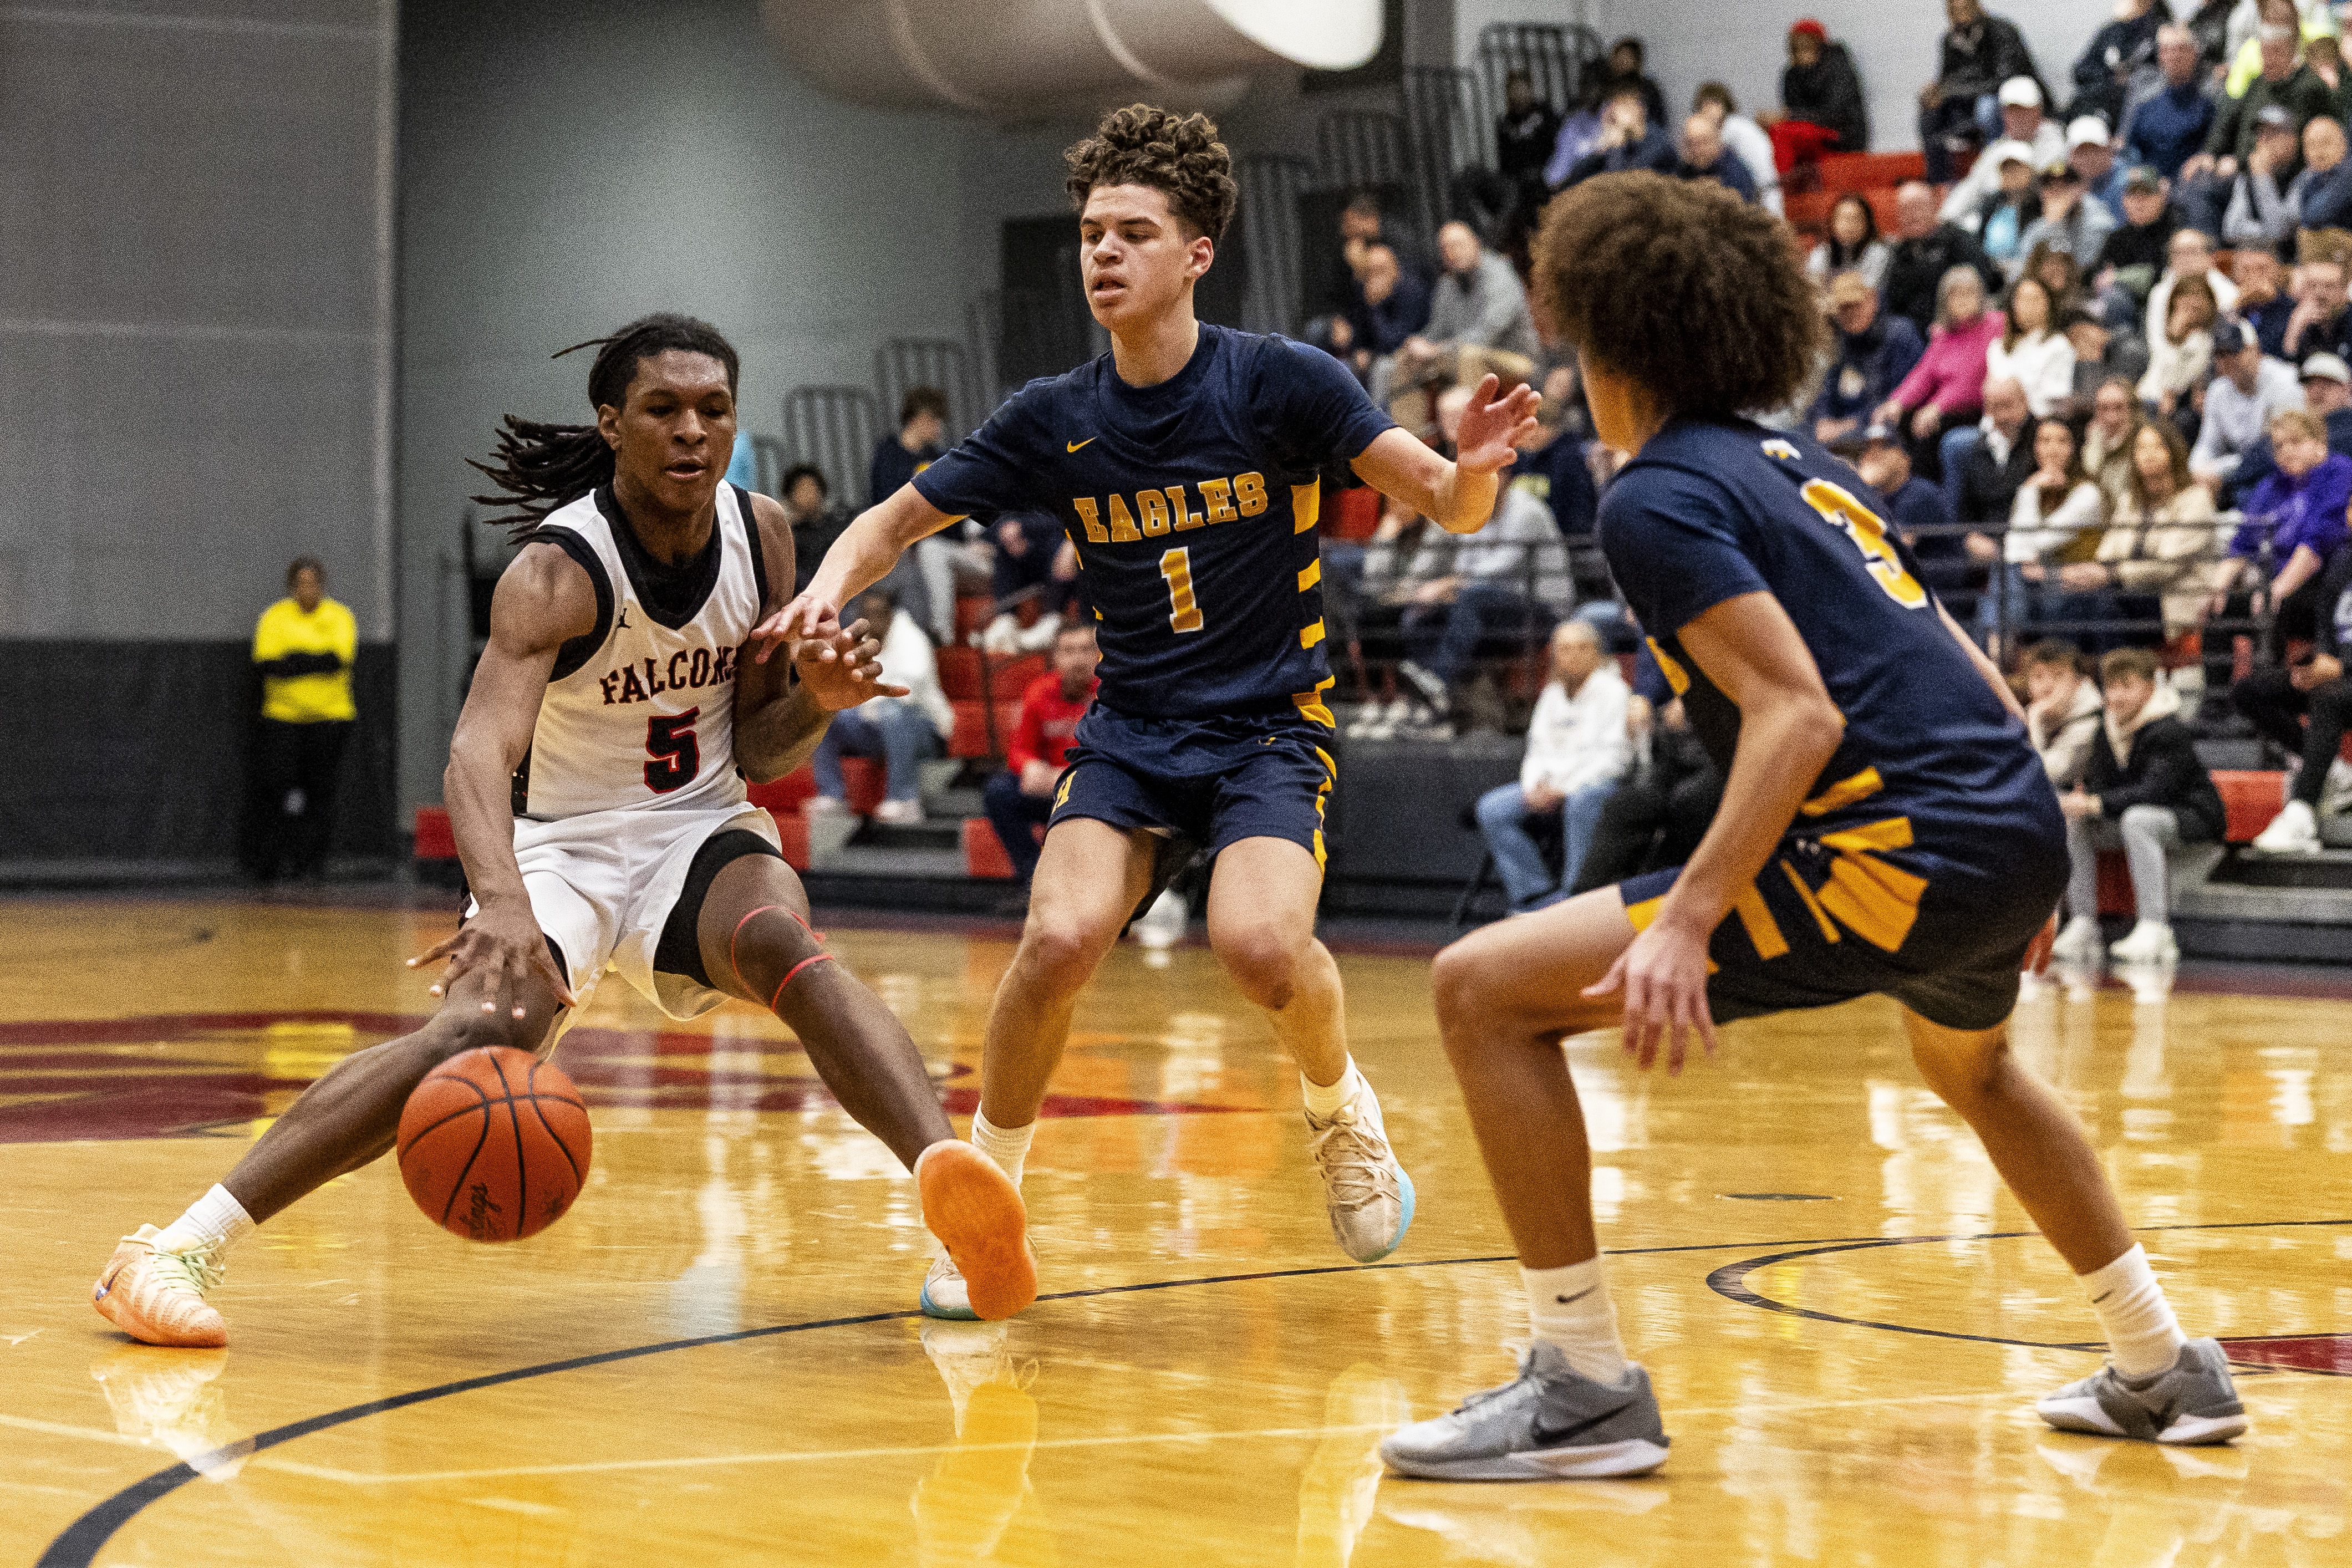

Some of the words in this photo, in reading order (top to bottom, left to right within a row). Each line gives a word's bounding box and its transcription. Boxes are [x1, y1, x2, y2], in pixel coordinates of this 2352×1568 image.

[1074, 472, 1268, 543] EAGLES
[1800, 478, 1928, 609] 3
[1160, 547, 1204, 634] 1
[644, 706, 700, 795] 5
